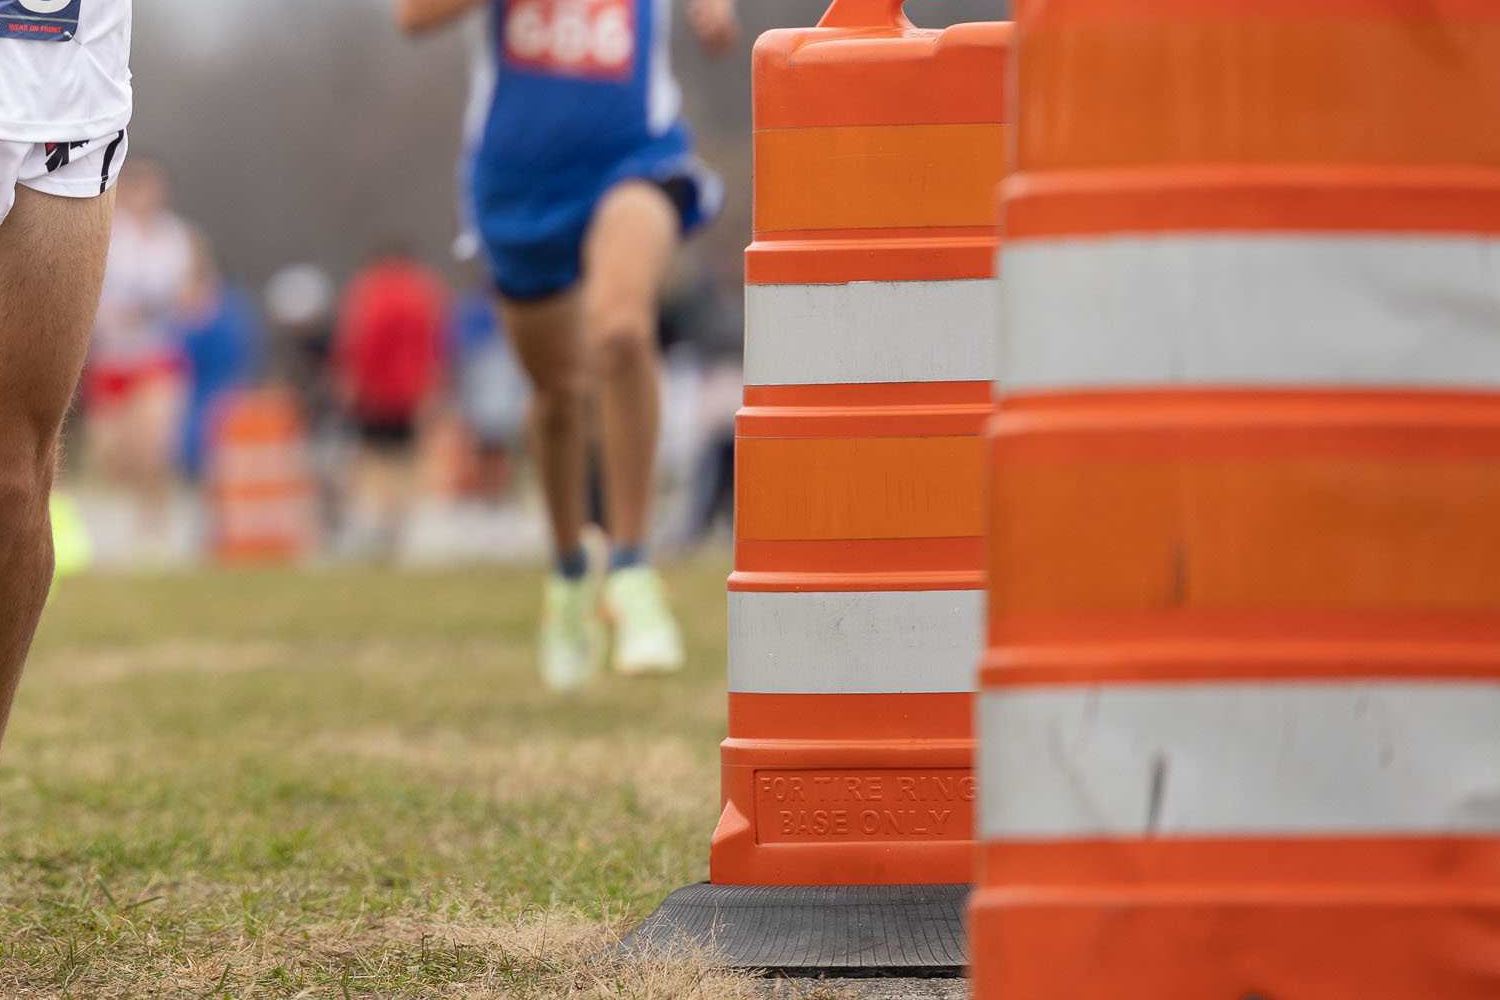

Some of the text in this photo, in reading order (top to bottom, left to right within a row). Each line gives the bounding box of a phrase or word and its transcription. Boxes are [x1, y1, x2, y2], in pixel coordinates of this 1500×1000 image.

[8, 23, 62, 33] WEAR ON FRONT
[759, 776, 980, 802] FOR TIRE RING
[779, 809, 952, 836] BASE ONLY
